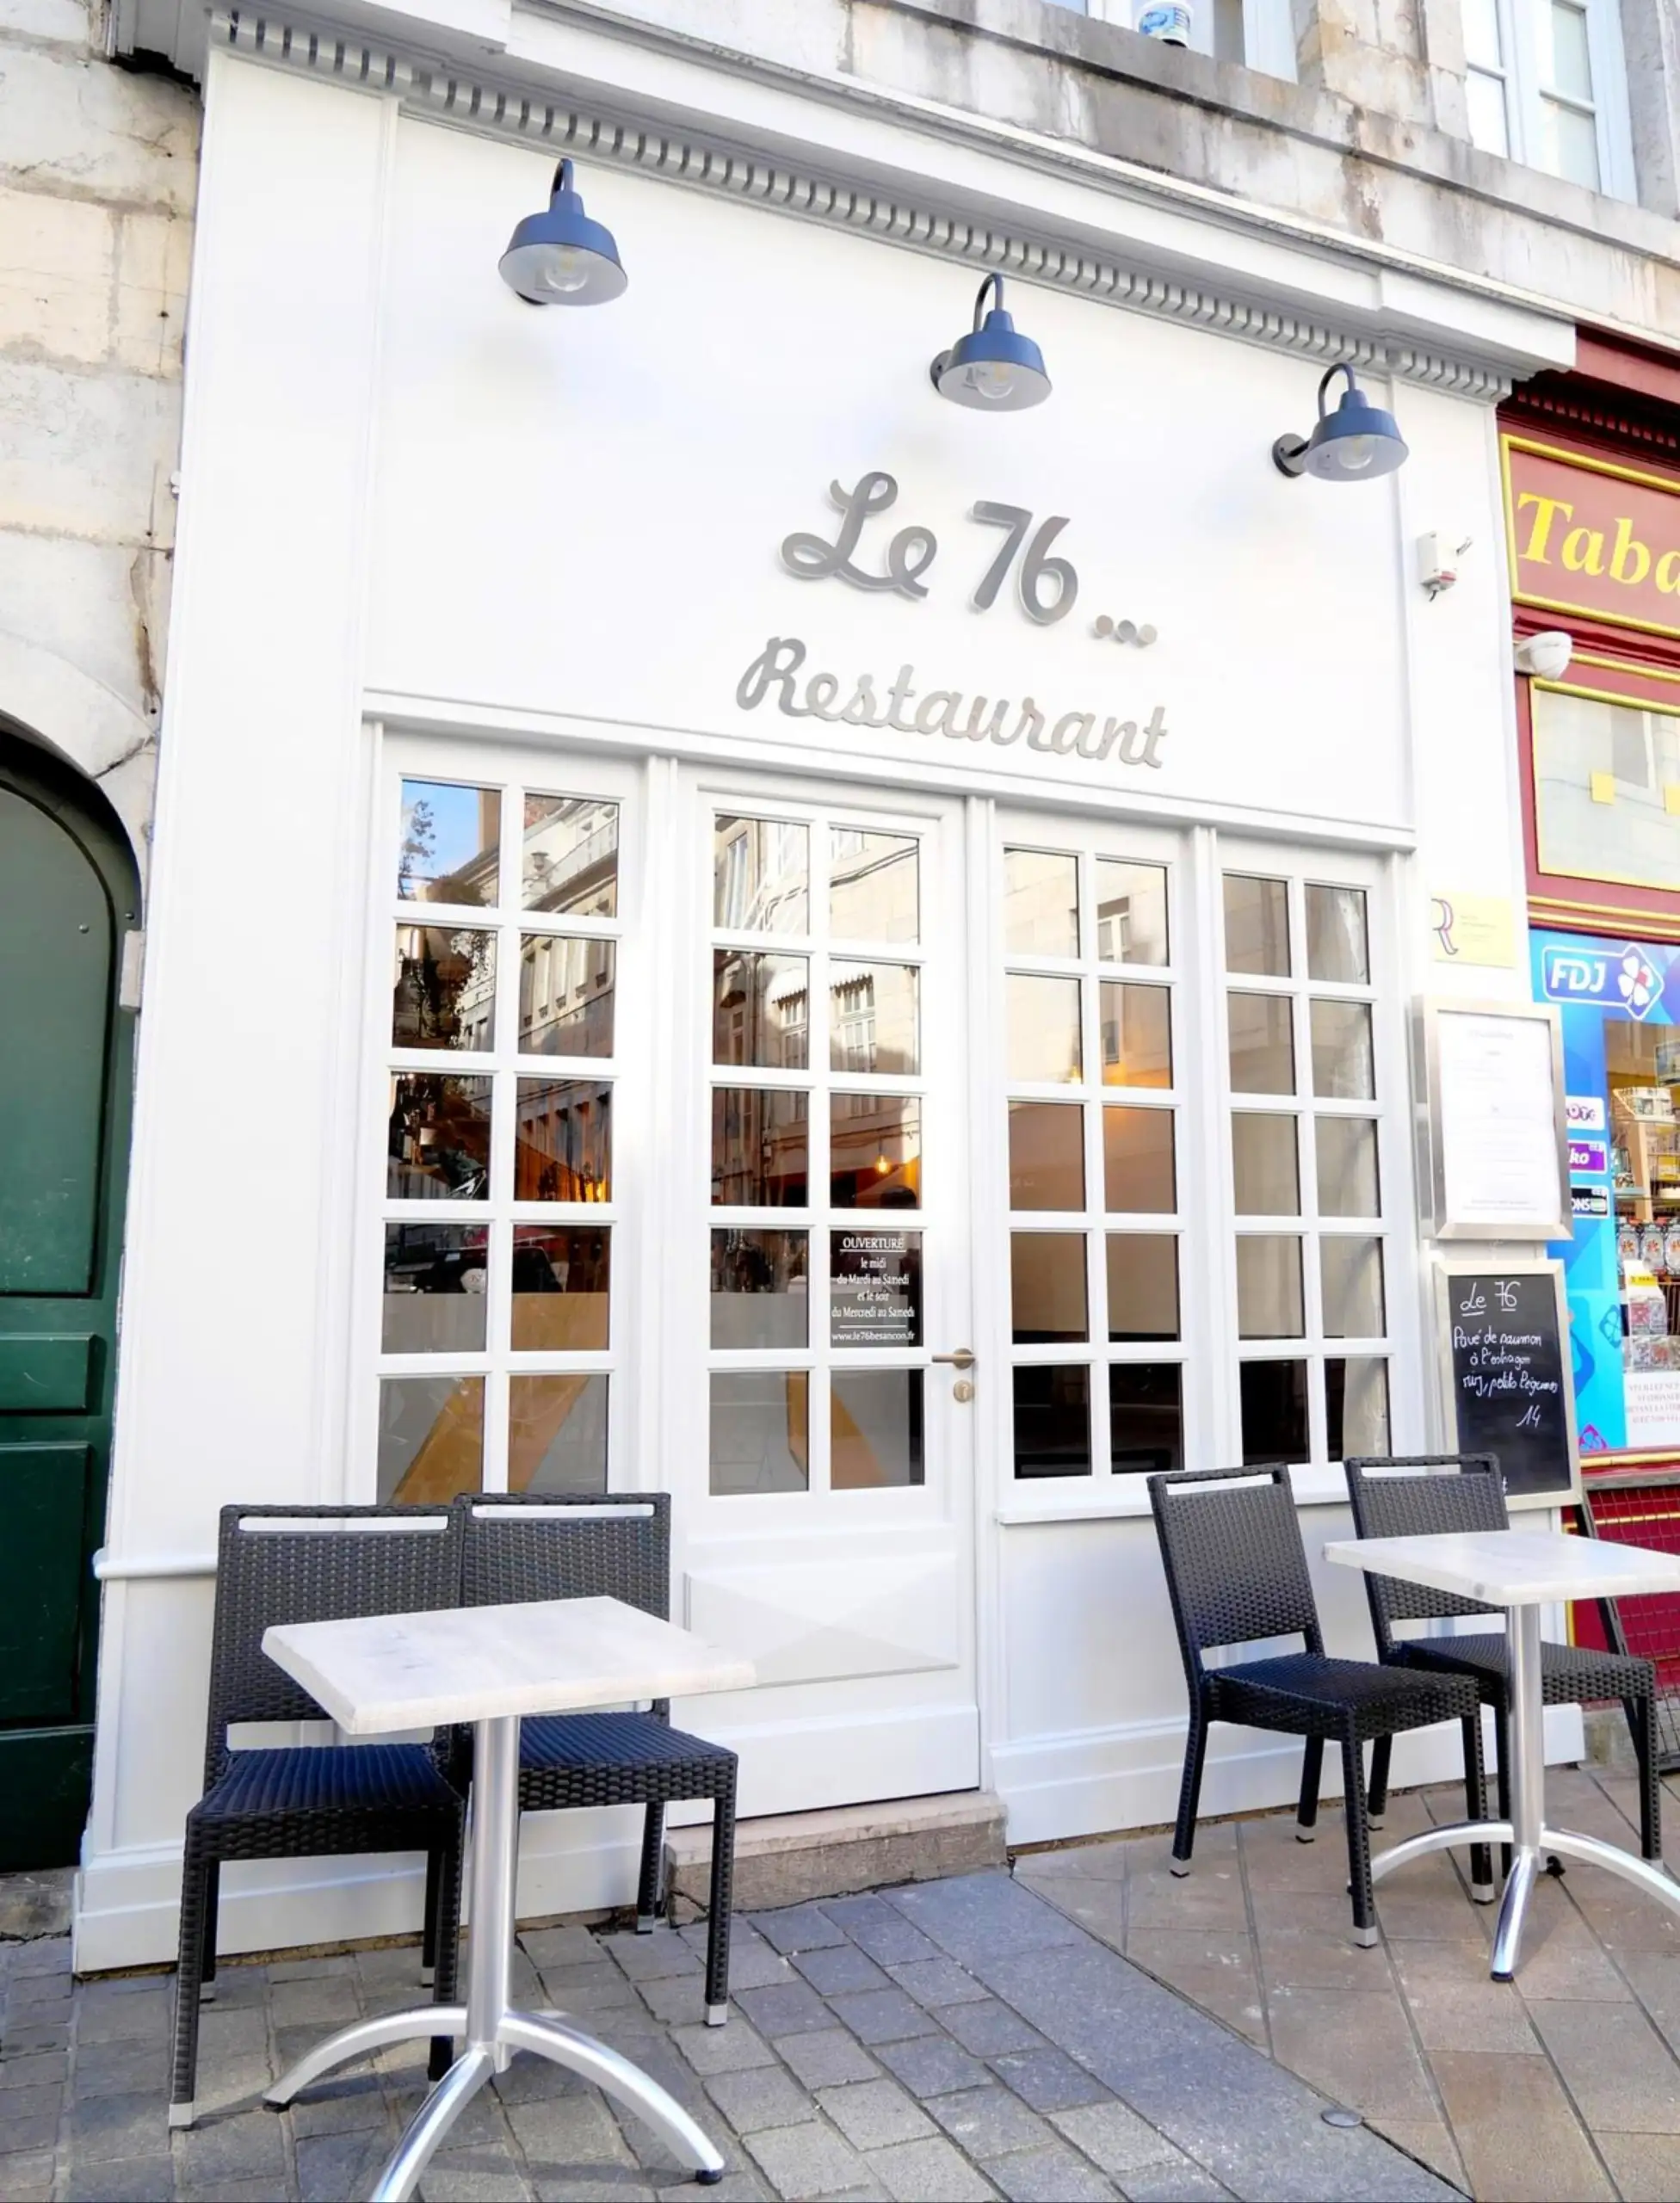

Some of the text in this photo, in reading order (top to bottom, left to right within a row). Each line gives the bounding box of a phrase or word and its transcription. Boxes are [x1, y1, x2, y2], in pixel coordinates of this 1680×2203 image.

[781, 471, 938, 599] Le
[735, 636, 1169, 769] Restaurant
[1550, 957, 1607, 993] FDJ
[843, 1237, 905, 1249] OUVERTURE
[861, 1256, 886, 1268] le midi
[837, 1274, 910, 1285] du Mardi au Samedi
[857, 1289, 890, 1301] et le soir
[1460, 1280, 1521, 1311] Le 76
[831, 1306, 915, 1317] du Mercredi au Samedi
[1454, 1325, 1541, 1349] Pavé de saumon
[1469, 1352, 1479, 1366] à
[1515, 1404, 1541, 1427] 14
